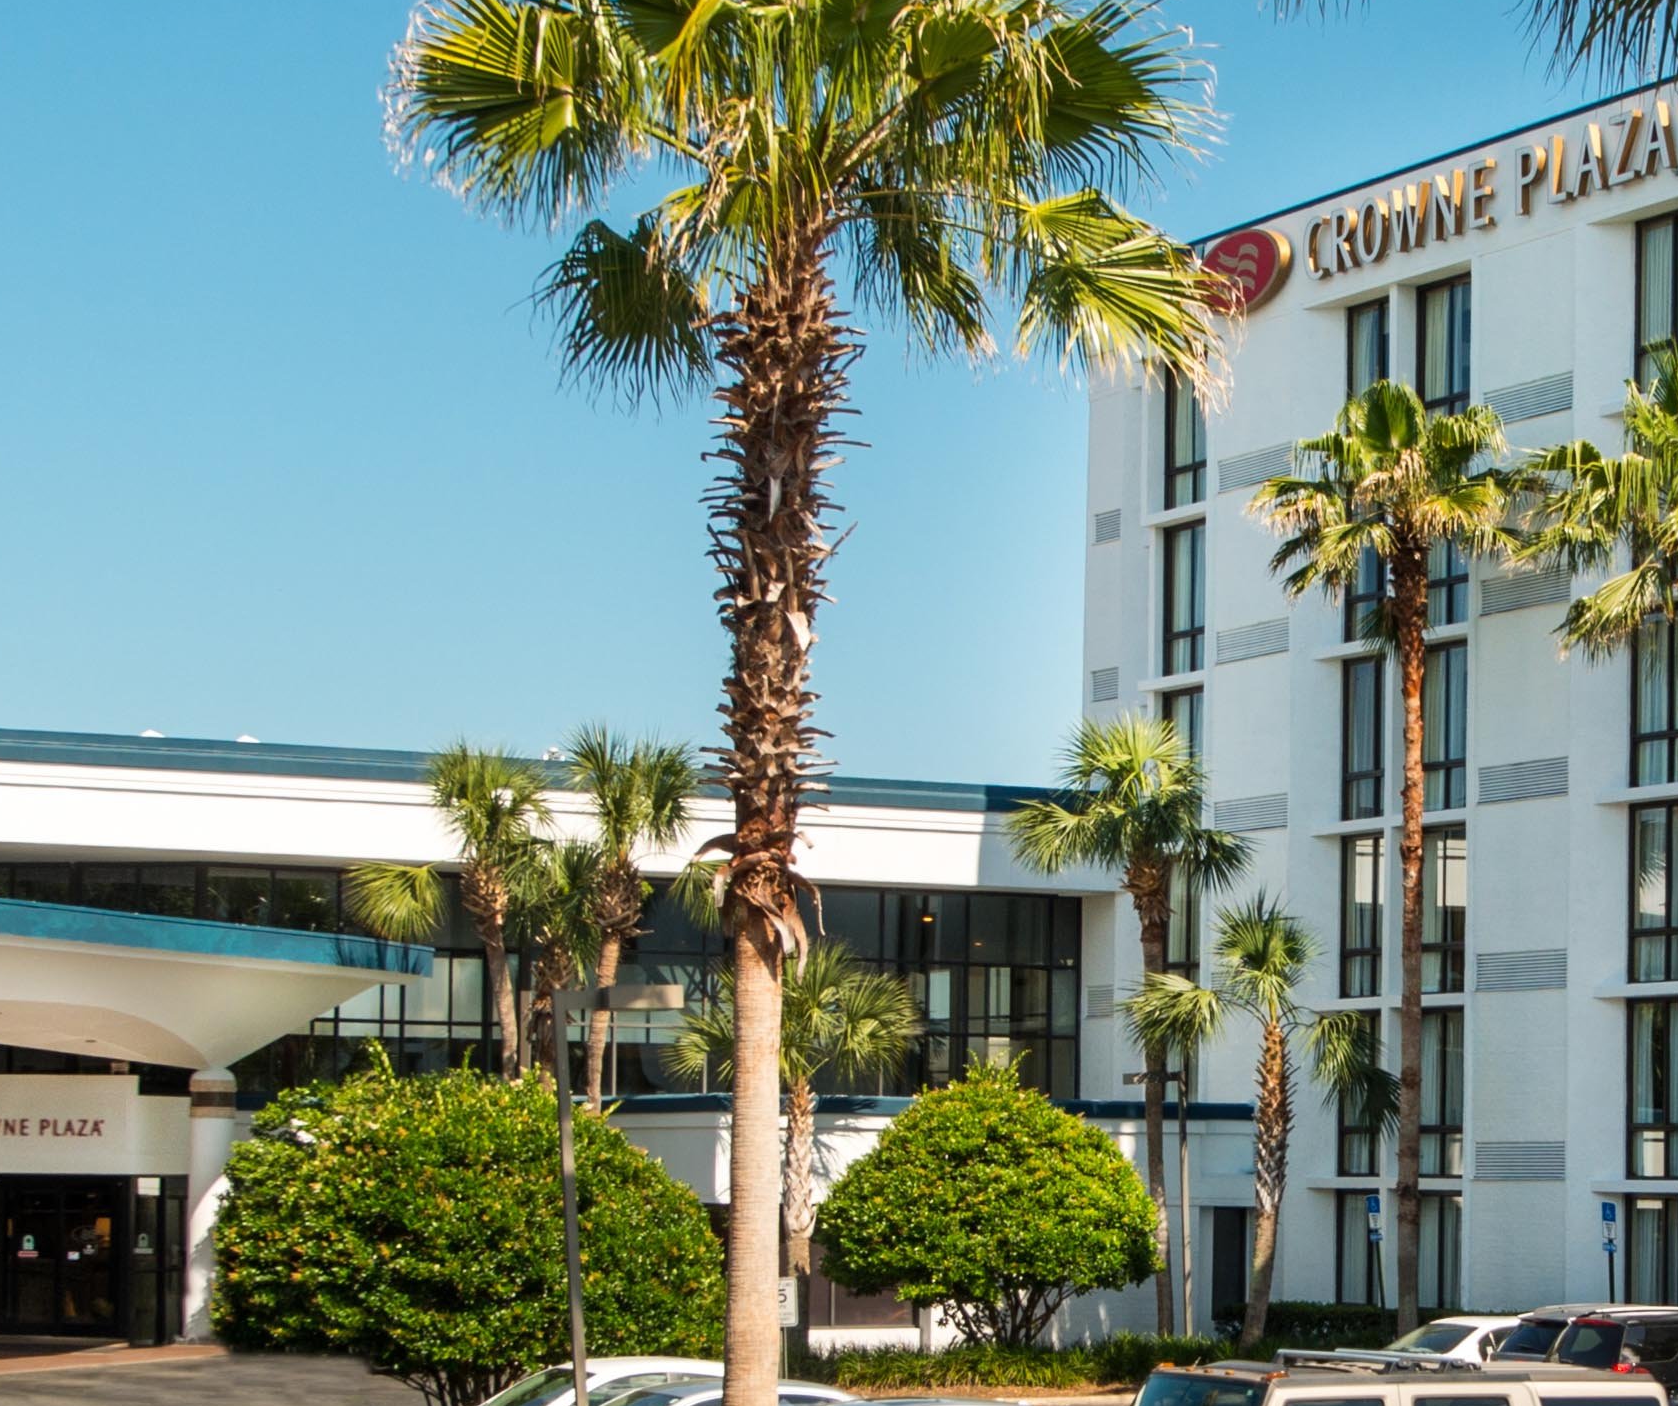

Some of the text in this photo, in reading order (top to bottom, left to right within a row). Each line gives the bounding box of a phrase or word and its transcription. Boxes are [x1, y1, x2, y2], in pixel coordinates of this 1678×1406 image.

[1304, 100, 1678, 280] CROWNE PLAZA
[38, 1118, 103, 1136] PLAZA
